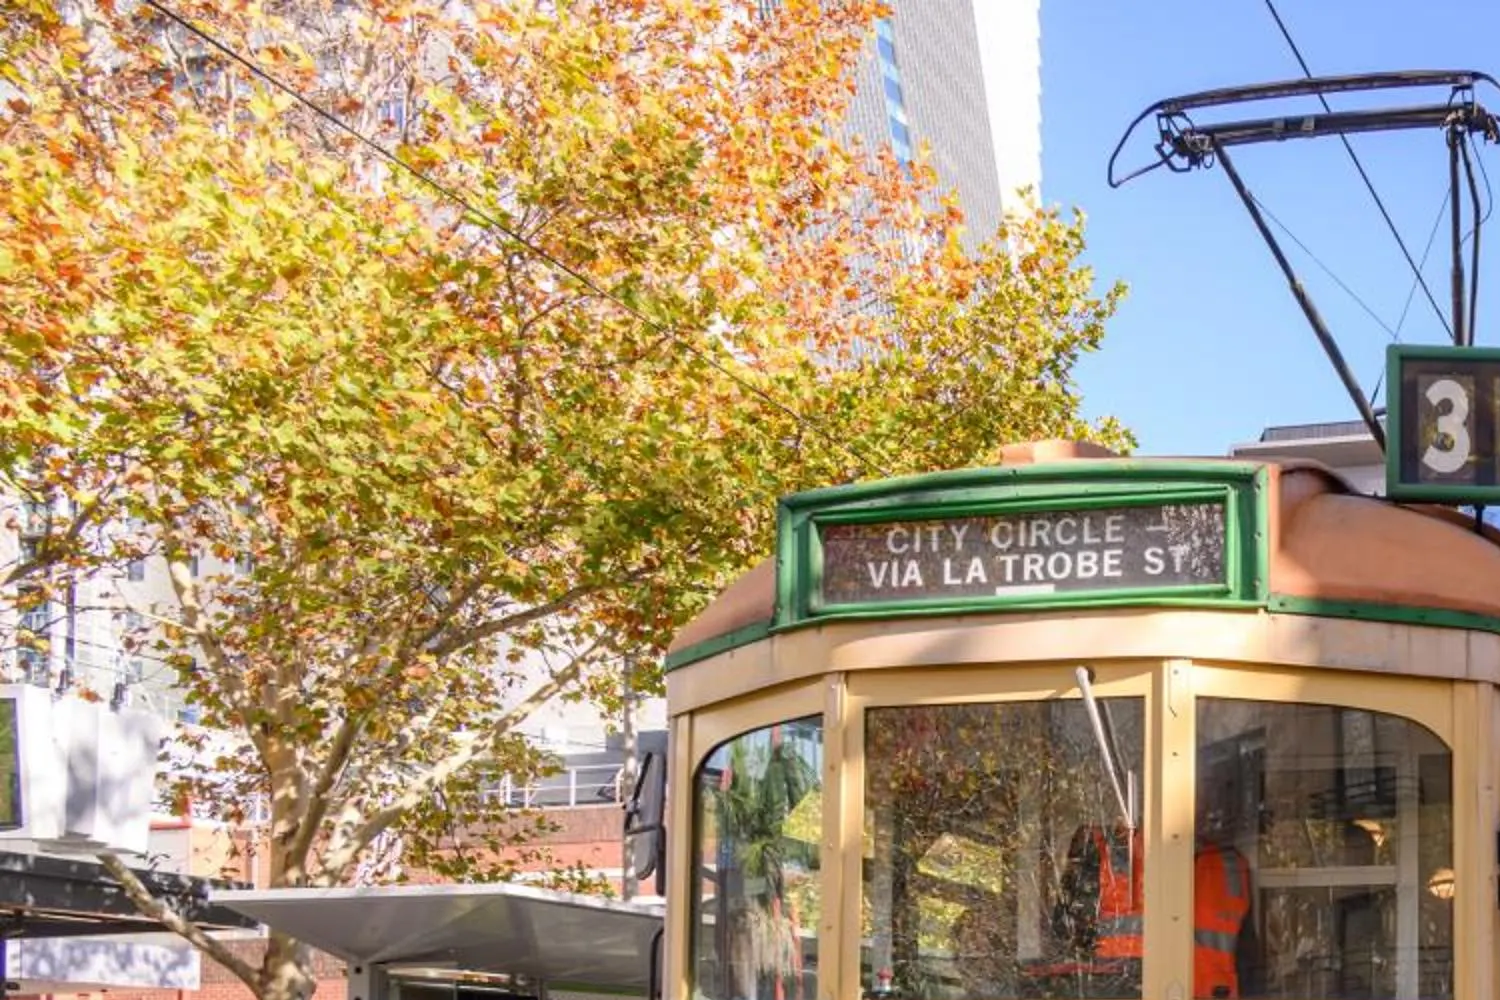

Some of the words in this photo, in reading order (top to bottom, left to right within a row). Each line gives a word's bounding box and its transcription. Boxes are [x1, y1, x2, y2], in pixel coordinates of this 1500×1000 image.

[886, 525, 969, 554] CITY
[991, 515, 1126, 550] CIRCLE
[867, 561, 924, 589] VIA
[943, 557, 987, 585] LA
[1001, 548, 1123, 581] TROBE
